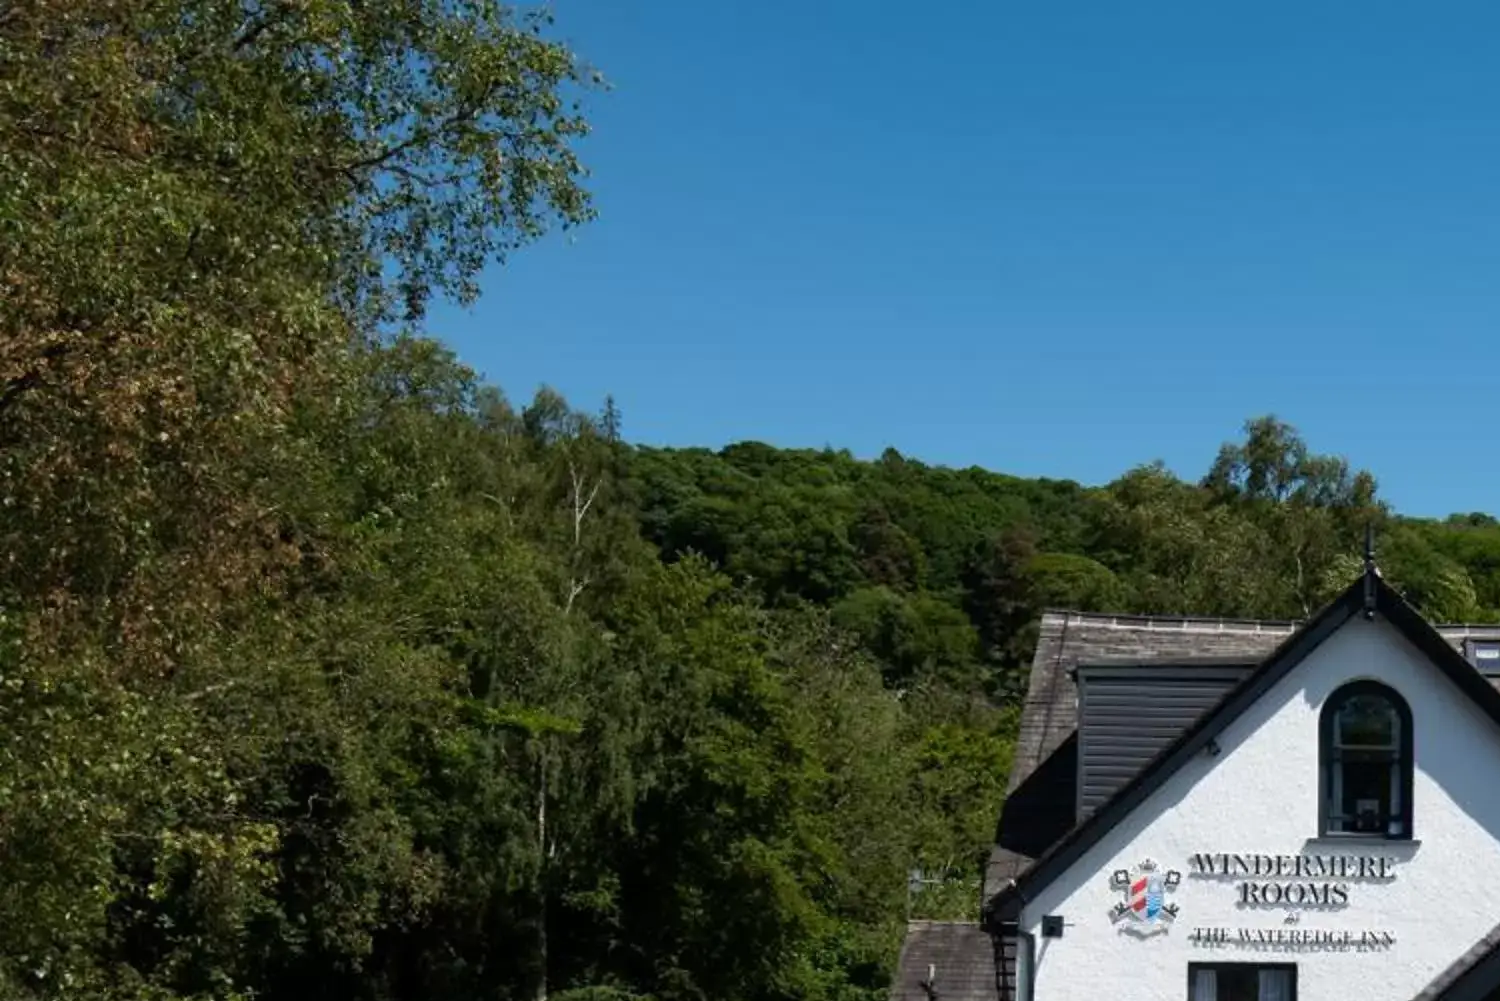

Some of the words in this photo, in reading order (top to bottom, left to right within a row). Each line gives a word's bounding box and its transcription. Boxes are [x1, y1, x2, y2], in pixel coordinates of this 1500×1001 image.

[1194, 853, 1396, 878] WINDERMERE
[1241, 882, 1348, 904] ROOMS
[1193, 927, 1231, 942] THE
[1360, 930, 1395, 945] INN
